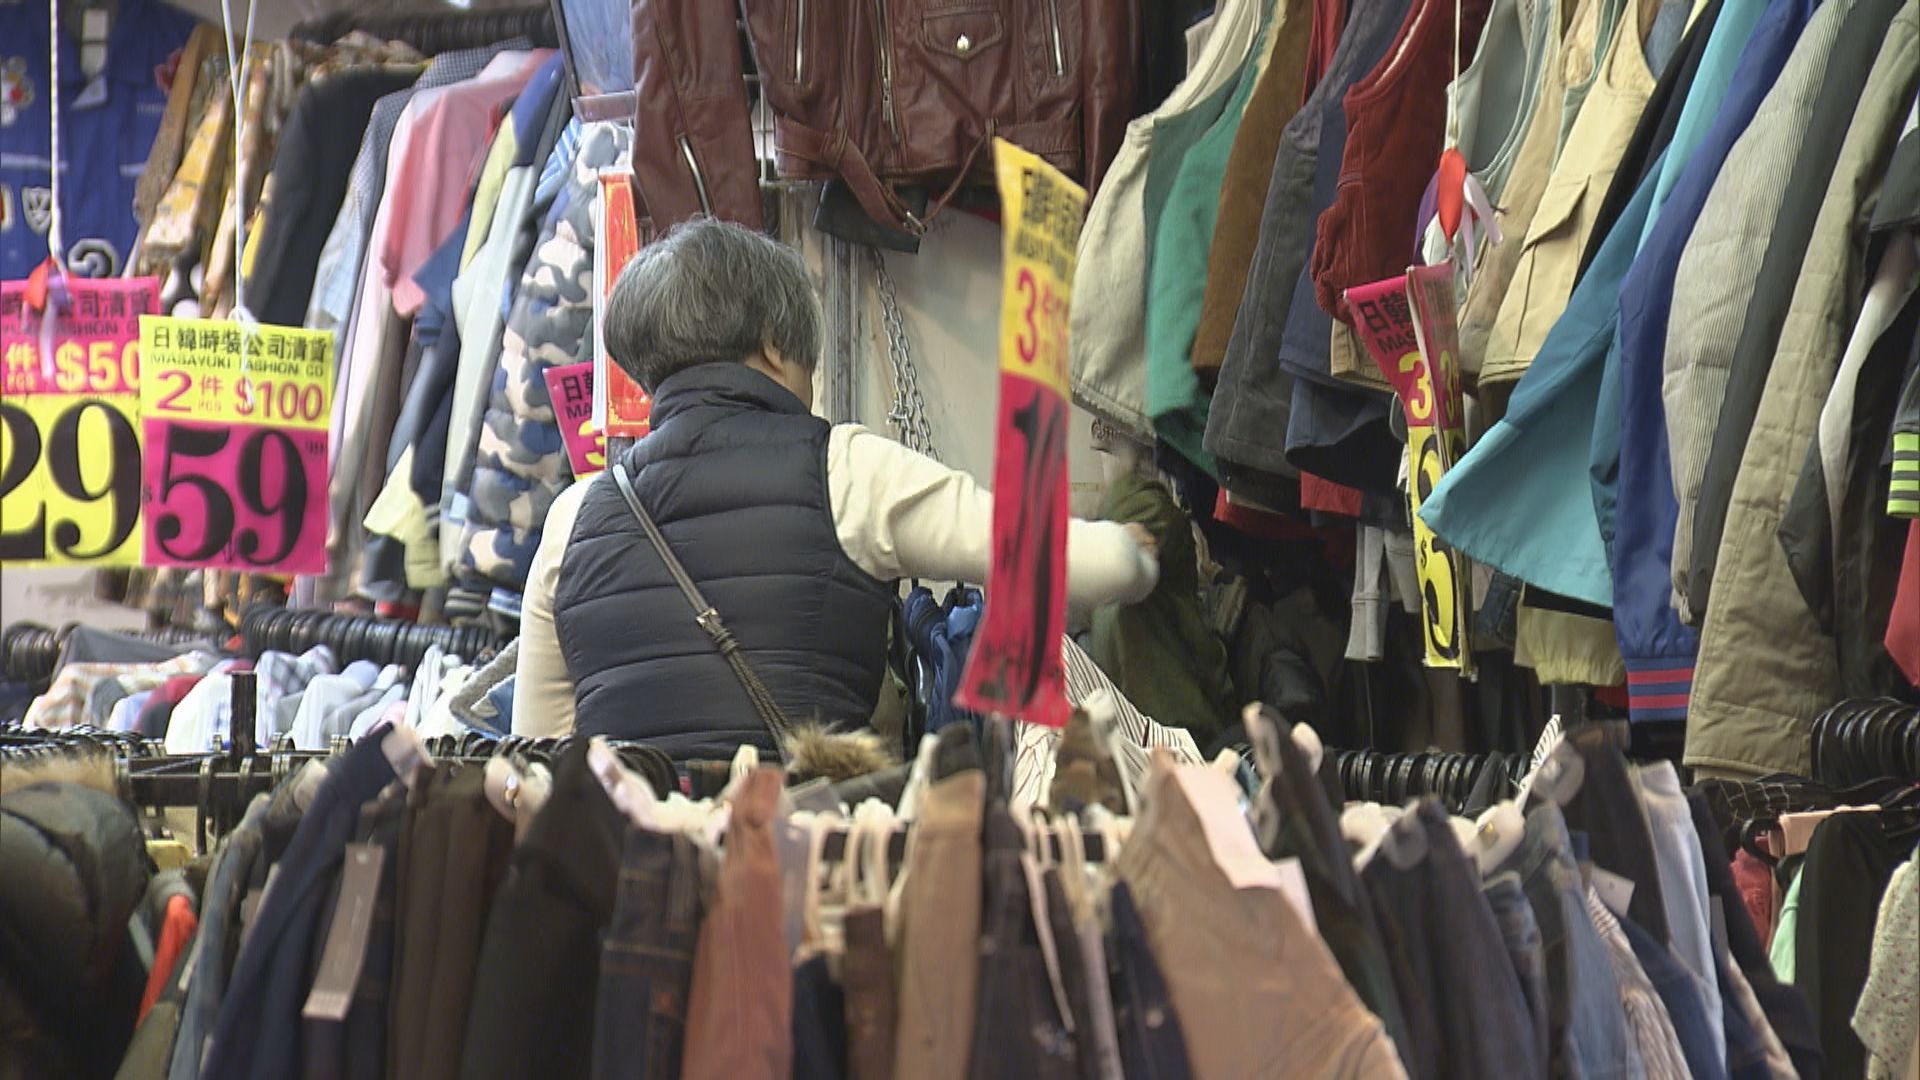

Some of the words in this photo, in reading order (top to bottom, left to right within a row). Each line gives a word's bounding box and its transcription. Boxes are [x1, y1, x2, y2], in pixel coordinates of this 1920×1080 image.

[1015, 266, 1038, 364] 3
[156, 369, 193, 412] 2
[200, 374, 224, 396] 件
[235, 376, 323, 421] $100
[1399, 352, 1433, 420] 3
[155, 423, 307, 565] 59
